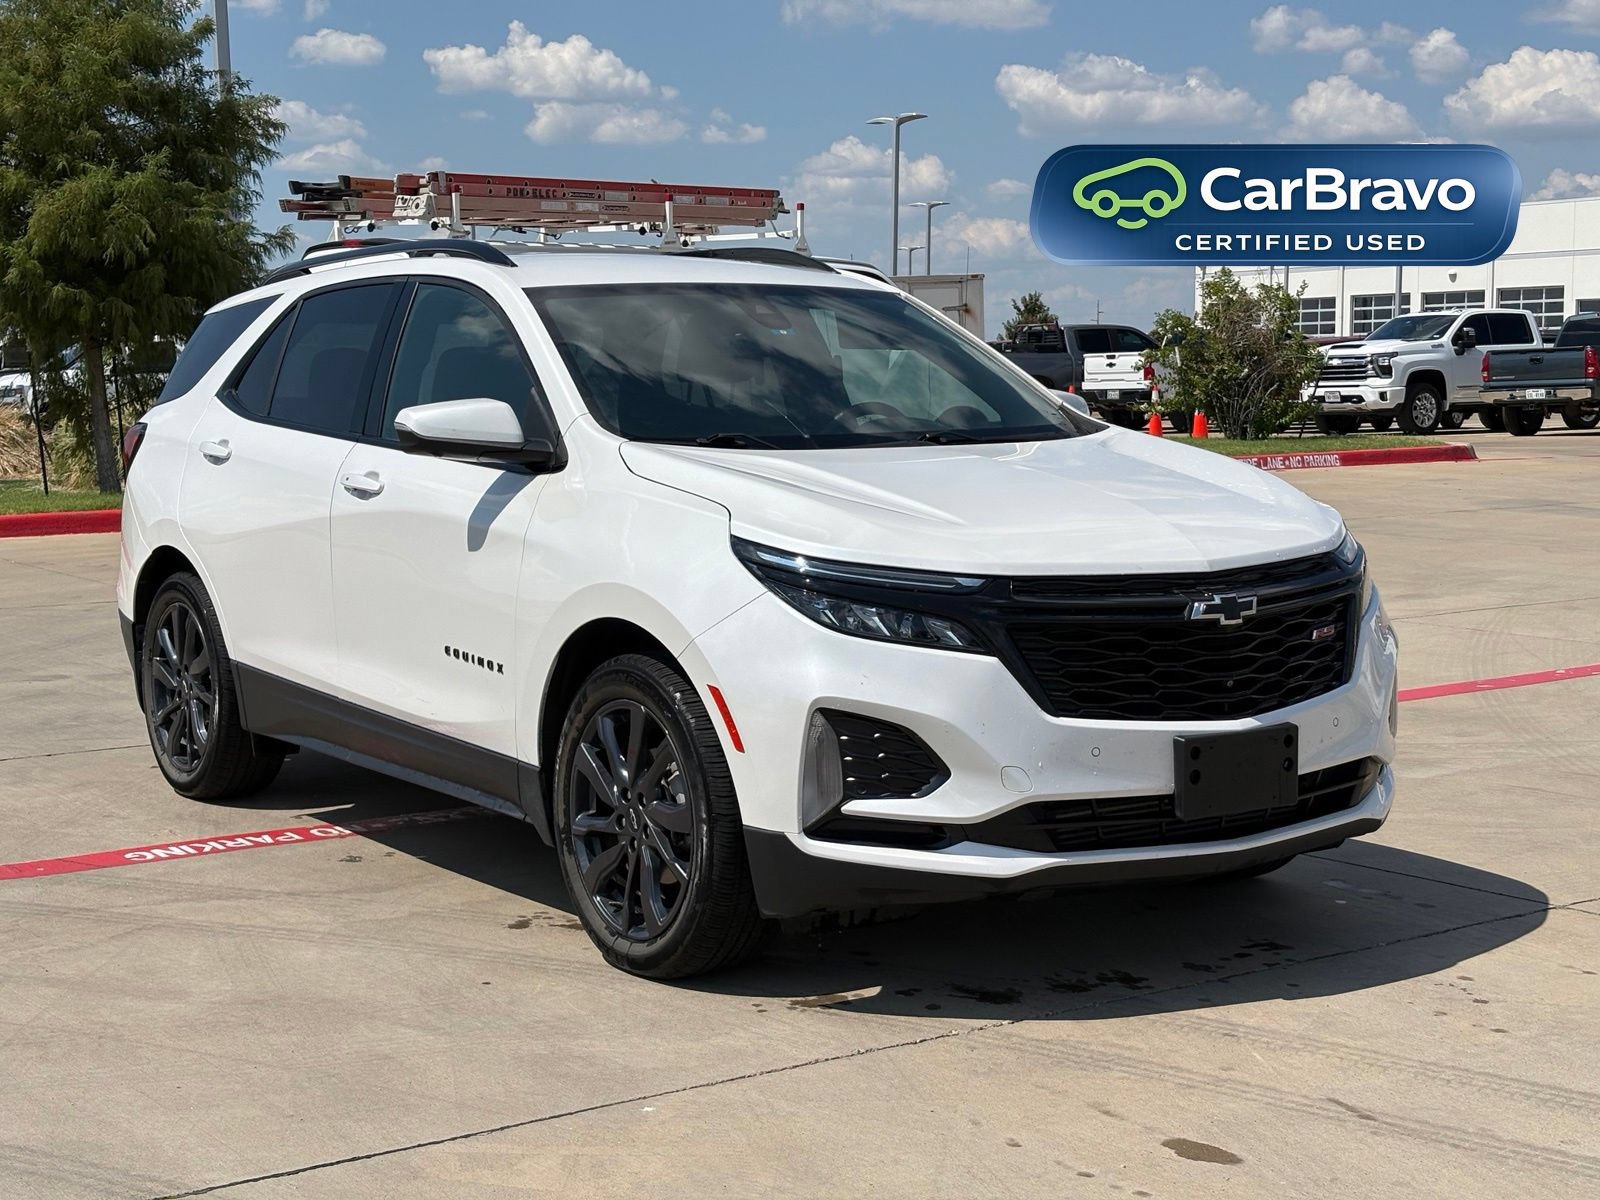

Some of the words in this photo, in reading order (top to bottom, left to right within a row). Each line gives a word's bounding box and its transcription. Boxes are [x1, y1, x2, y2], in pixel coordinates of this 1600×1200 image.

[1261, 457, 1285, 470] LANE
[1289, 456, 1302, 468] NO
[1304, 455, 1340, 467] PARKING
[444, 645, 504, 675] EQUINOX
[123, 832, 305, 861] PARKING
